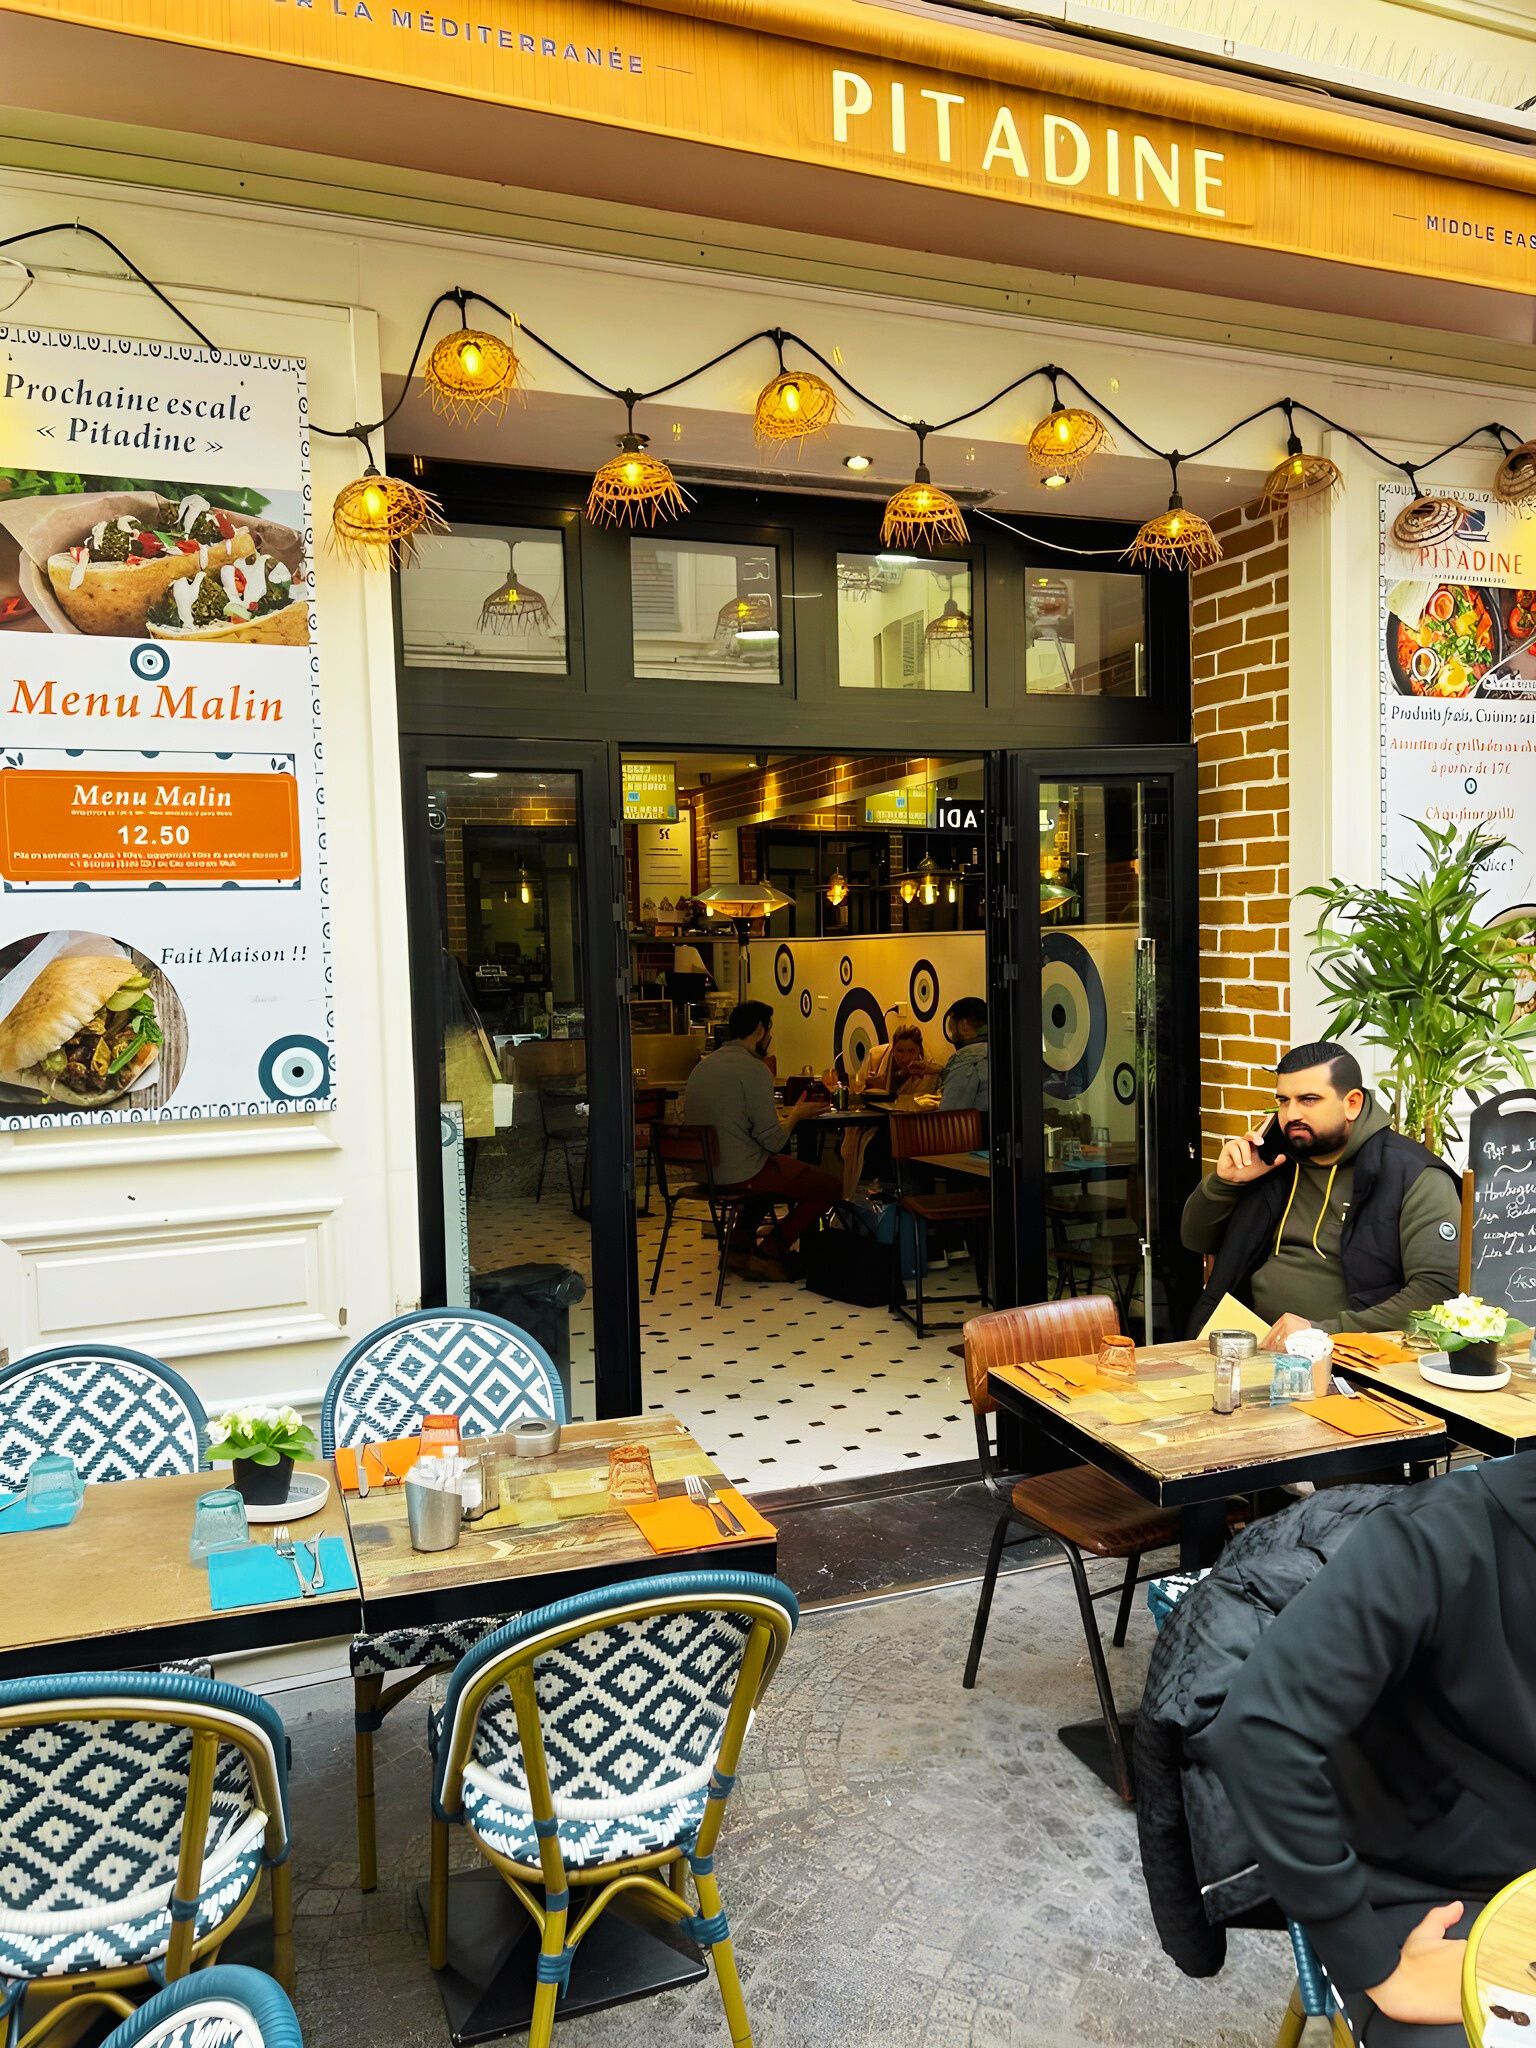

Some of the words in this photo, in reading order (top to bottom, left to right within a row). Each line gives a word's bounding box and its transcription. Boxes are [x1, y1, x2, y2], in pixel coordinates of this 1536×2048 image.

[333, 0, 373, 21] LA
[392, 8, 643, 74] MÉDITERRANÉE
[832, 69, 1226, 217] PITADINE
[1427, 215, 1495, 241] MIDDLE
[3, 373, 159, 412] Prochaine
[166, 395, 251, 422] escale
[66, 417, 197, 453] Pitadine
[1419, 546, 1523, 575] PITADINE
[8, 679, 140, 718] Menu
[150, 684, 283, 722] Malin
[71, 784, 147, 806] Menu
[154, 785, 232, 807] Malin
[117, 825, 190, 845] 12.50
[161, 947, 202, 964] Fait
[208, 947, 285, 963] Maison
